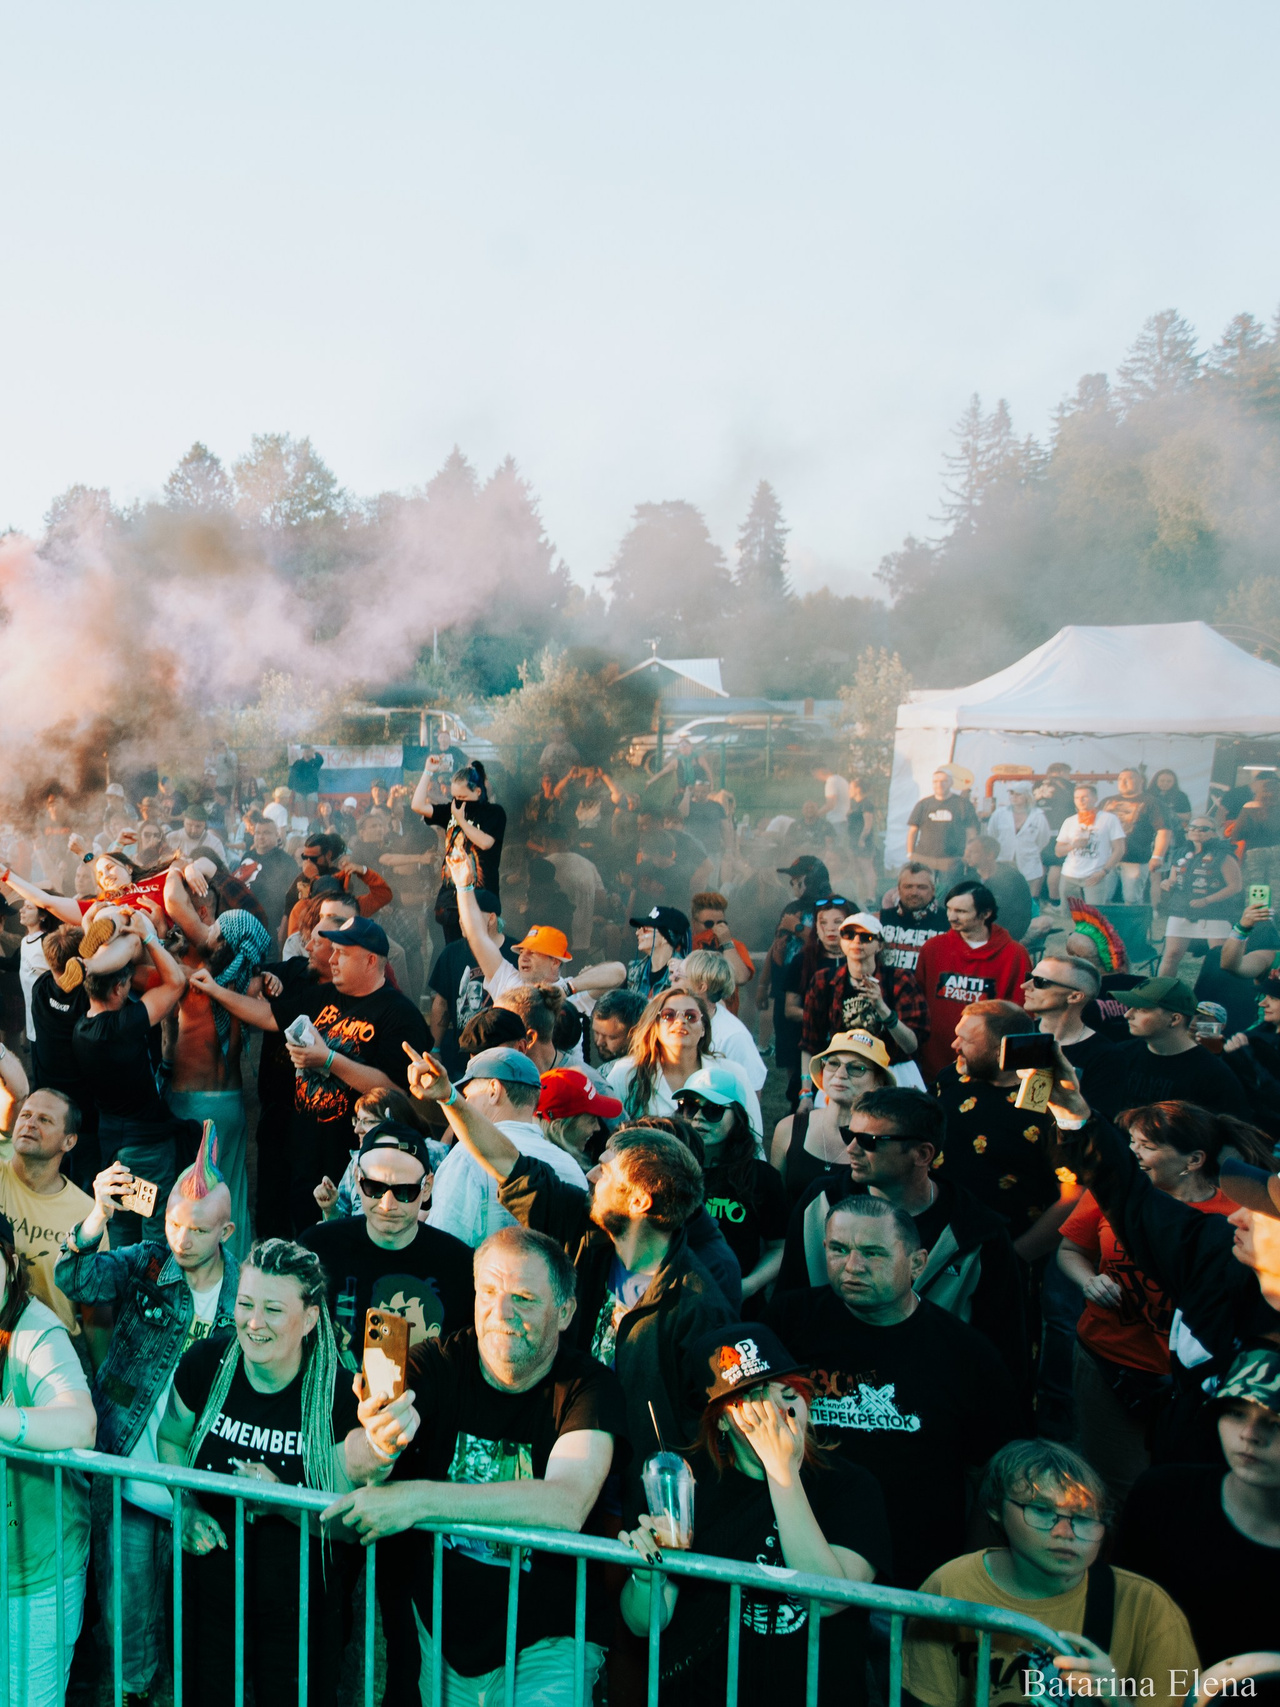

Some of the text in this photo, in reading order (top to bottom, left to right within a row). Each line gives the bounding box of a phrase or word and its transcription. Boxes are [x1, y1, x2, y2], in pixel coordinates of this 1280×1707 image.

[945, 975, 989, 992] ANTI-
[944, 986, 983, 1004] PARTY
[810, 1408, 915, 1430] ПЕРЕКРЕСТОК
